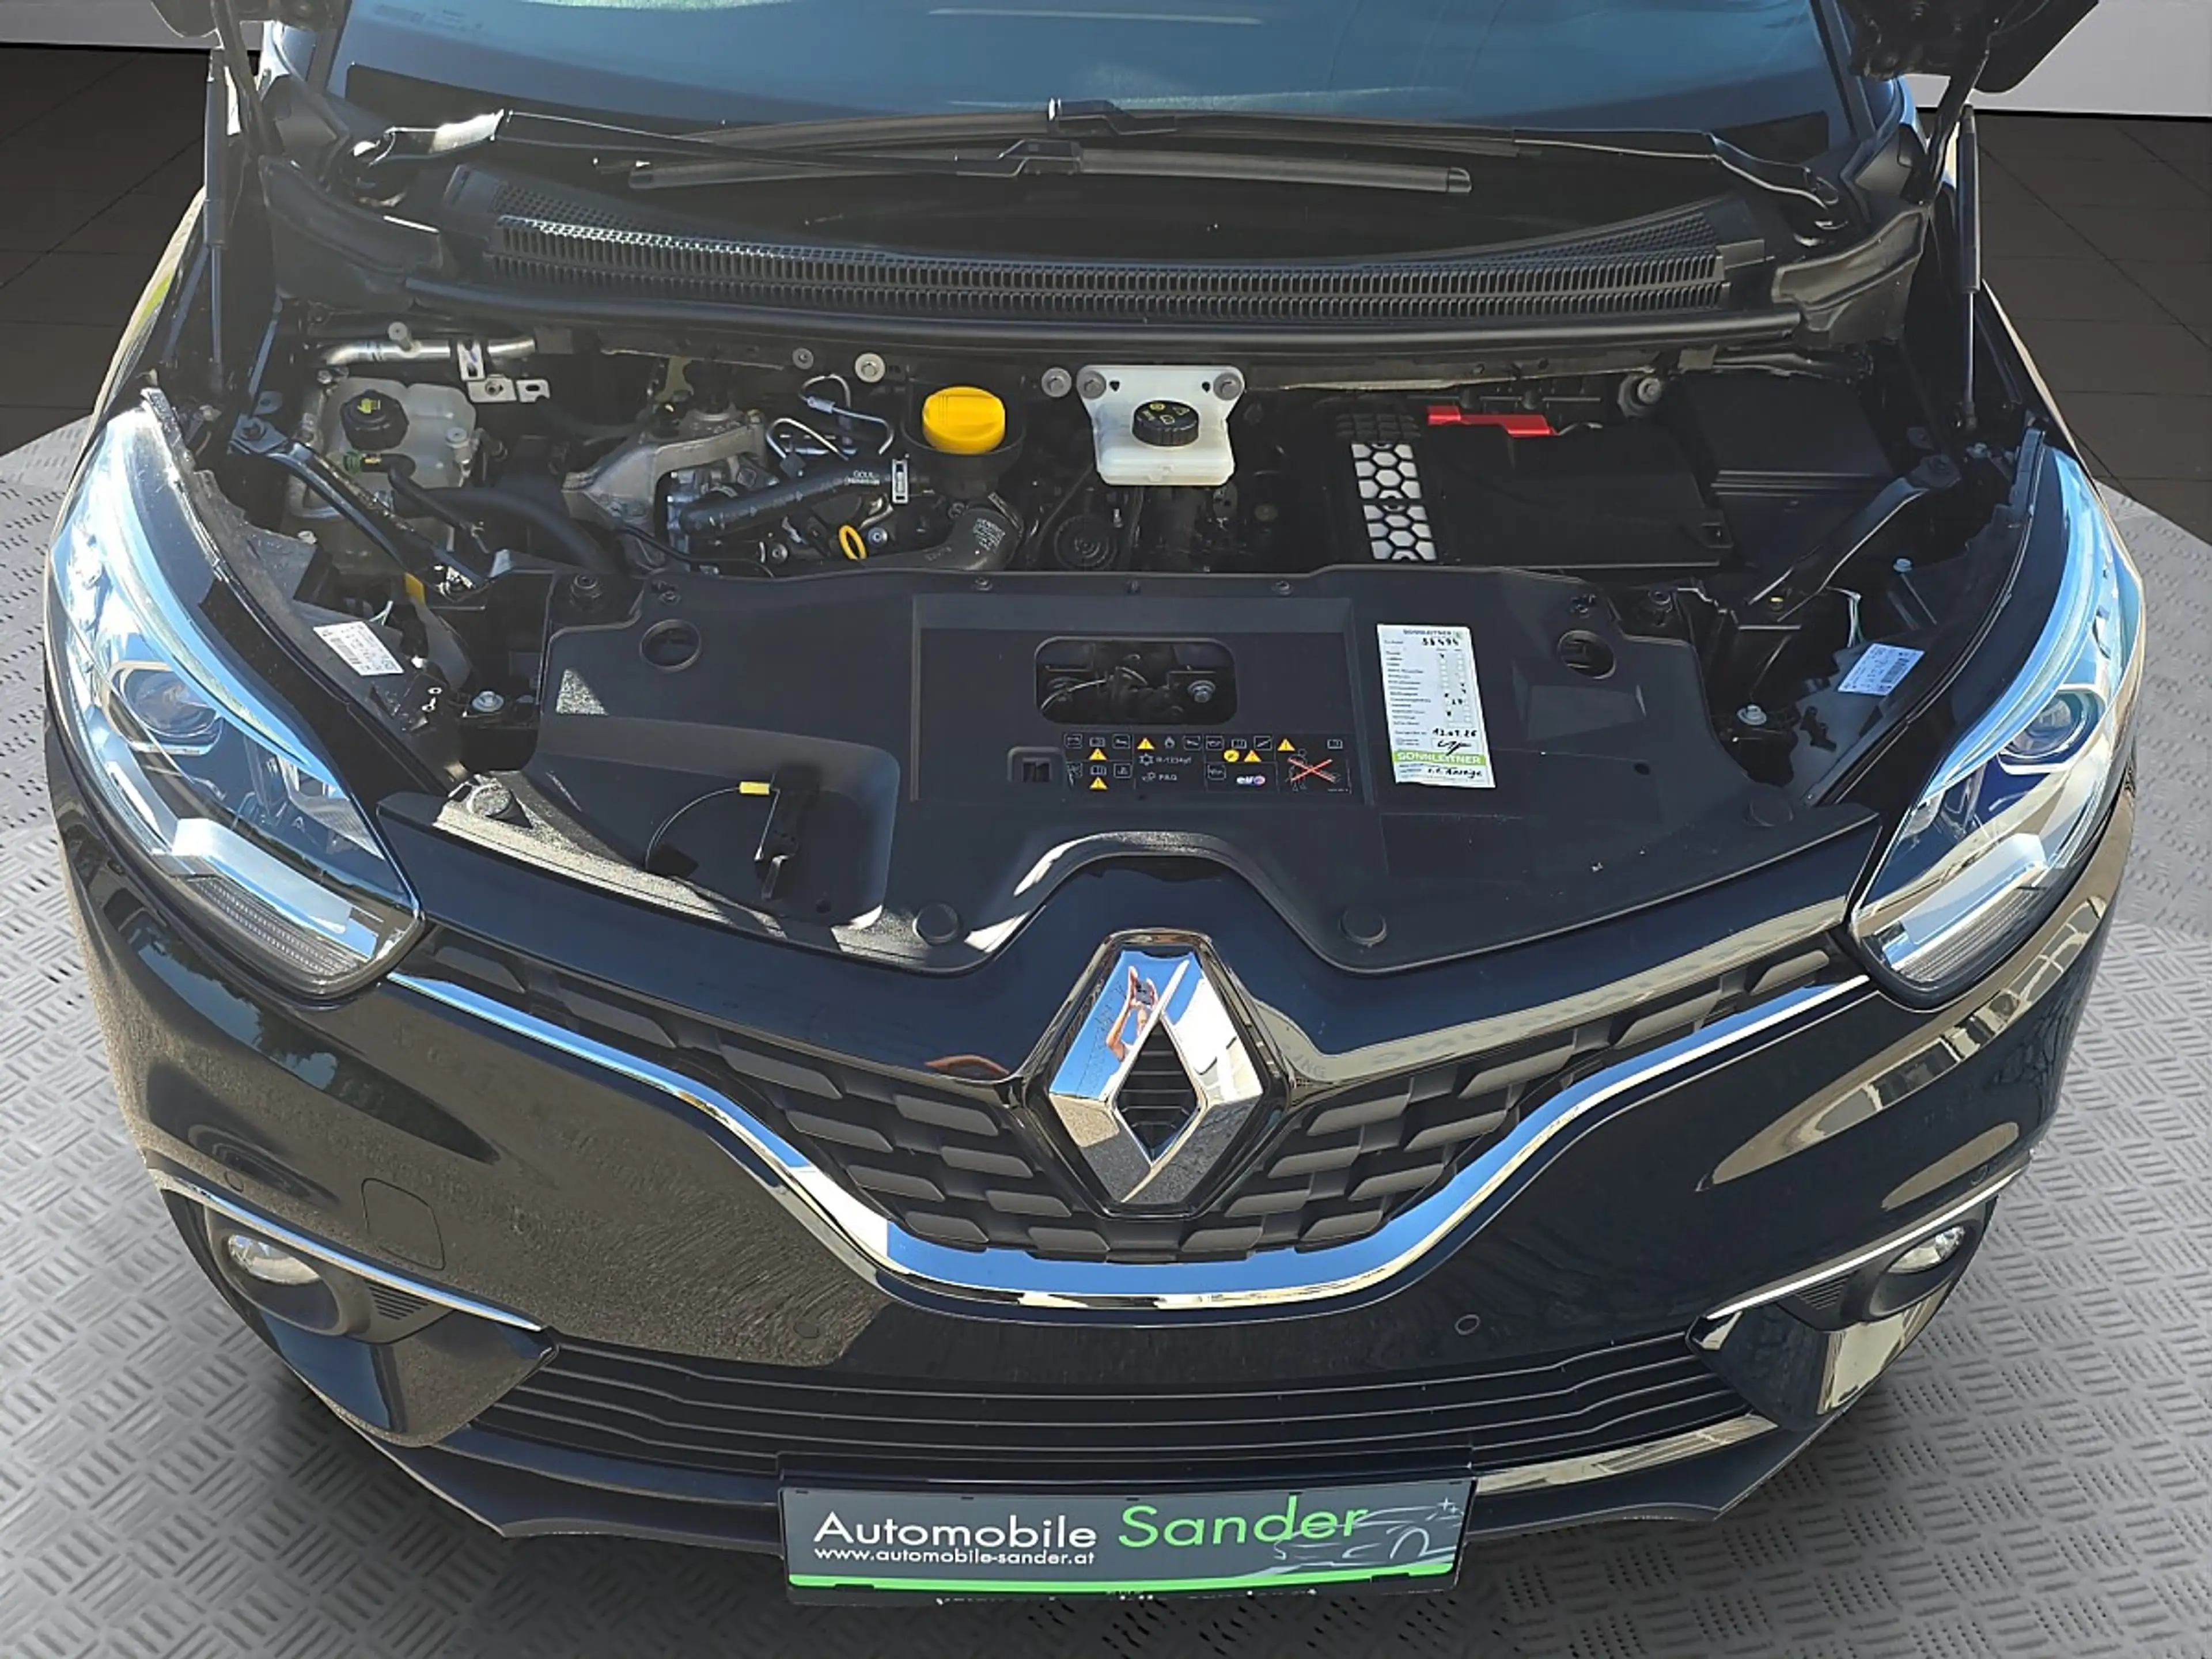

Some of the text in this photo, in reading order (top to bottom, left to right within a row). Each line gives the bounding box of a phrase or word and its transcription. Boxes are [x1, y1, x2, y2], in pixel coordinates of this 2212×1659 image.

[1397, 751, 1481, 764] SONNLEITNER
[813, 1494, 1369, 1548] Automobile Sander
[814, 1548, 1095, 1565] www.automobile-sander.at
